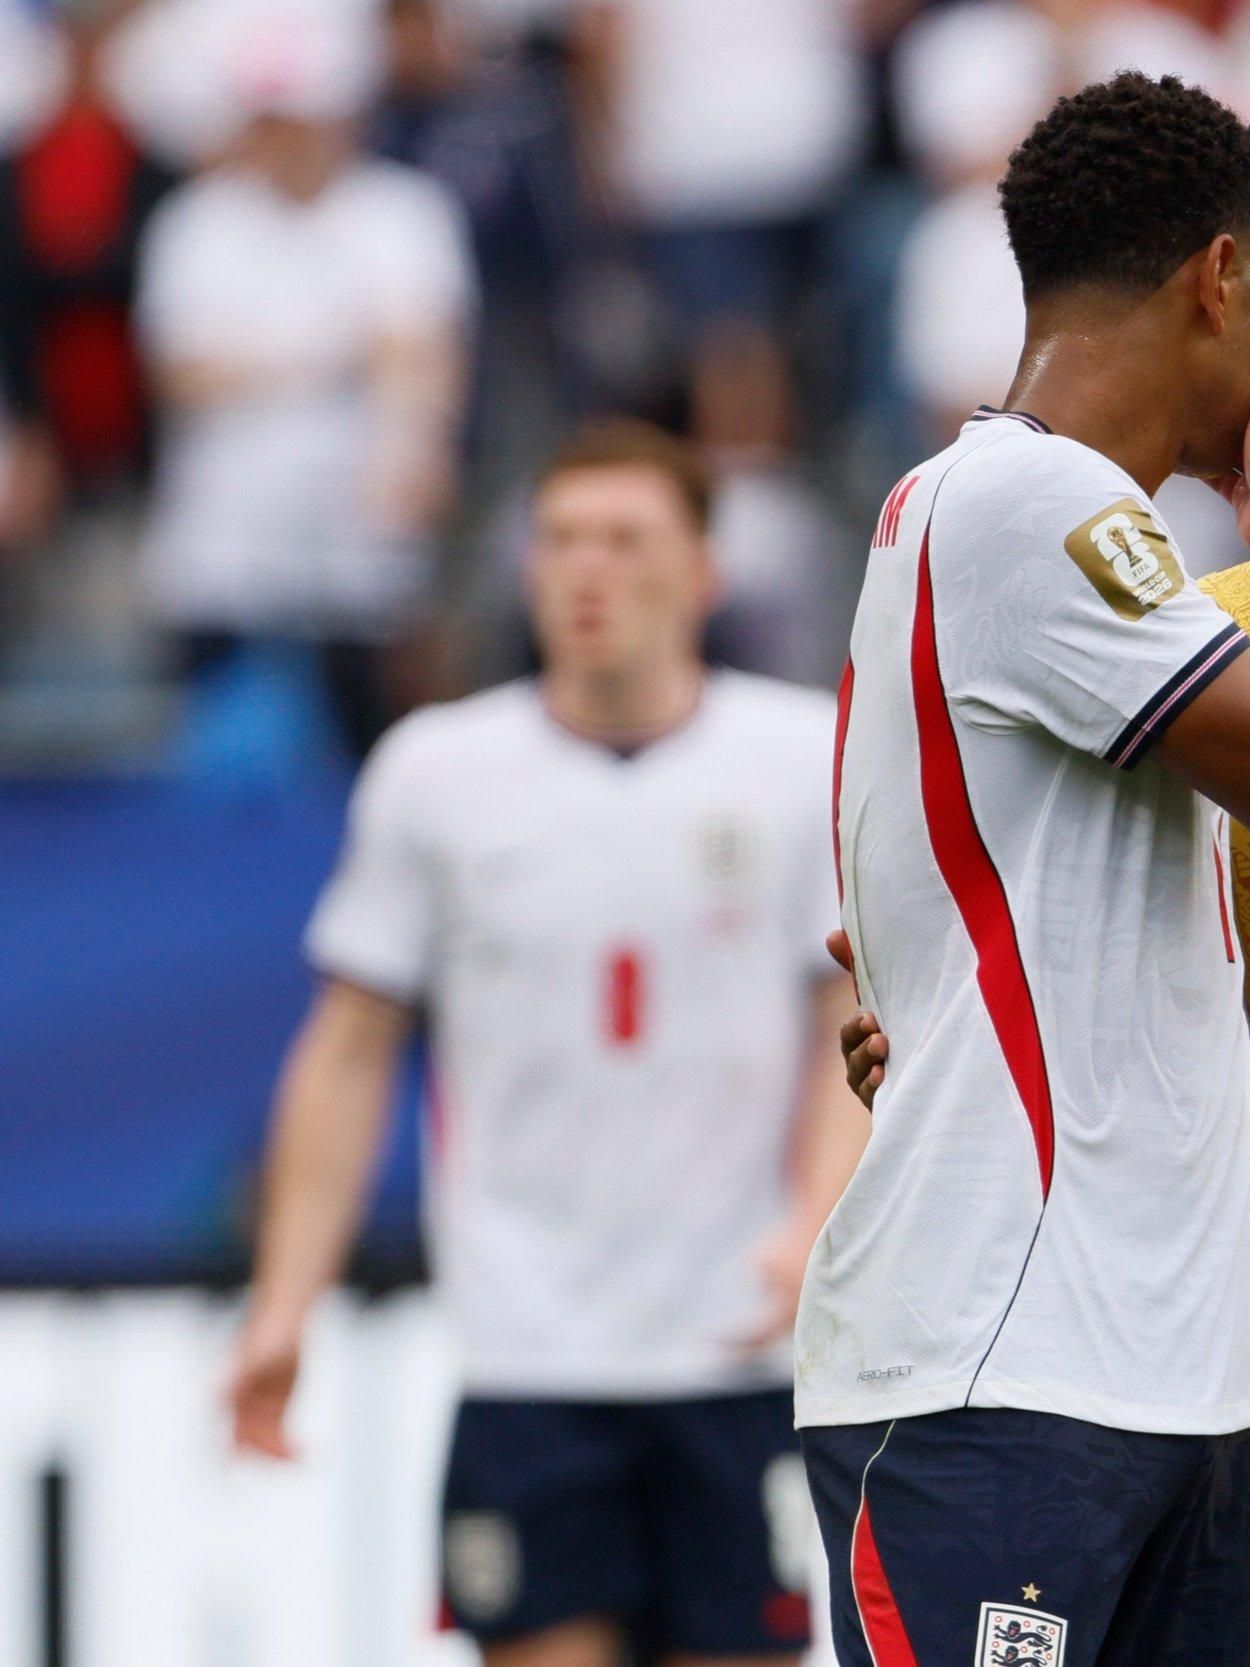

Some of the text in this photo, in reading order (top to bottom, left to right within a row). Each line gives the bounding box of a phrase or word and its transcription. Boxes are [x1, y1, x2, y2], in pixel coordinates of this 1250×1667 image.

[1132, 563, 1151, 578] FIFA
[1138, 578, 1173, 606] 2026
[857, 1365, 916, 1382] AERO-FIT
